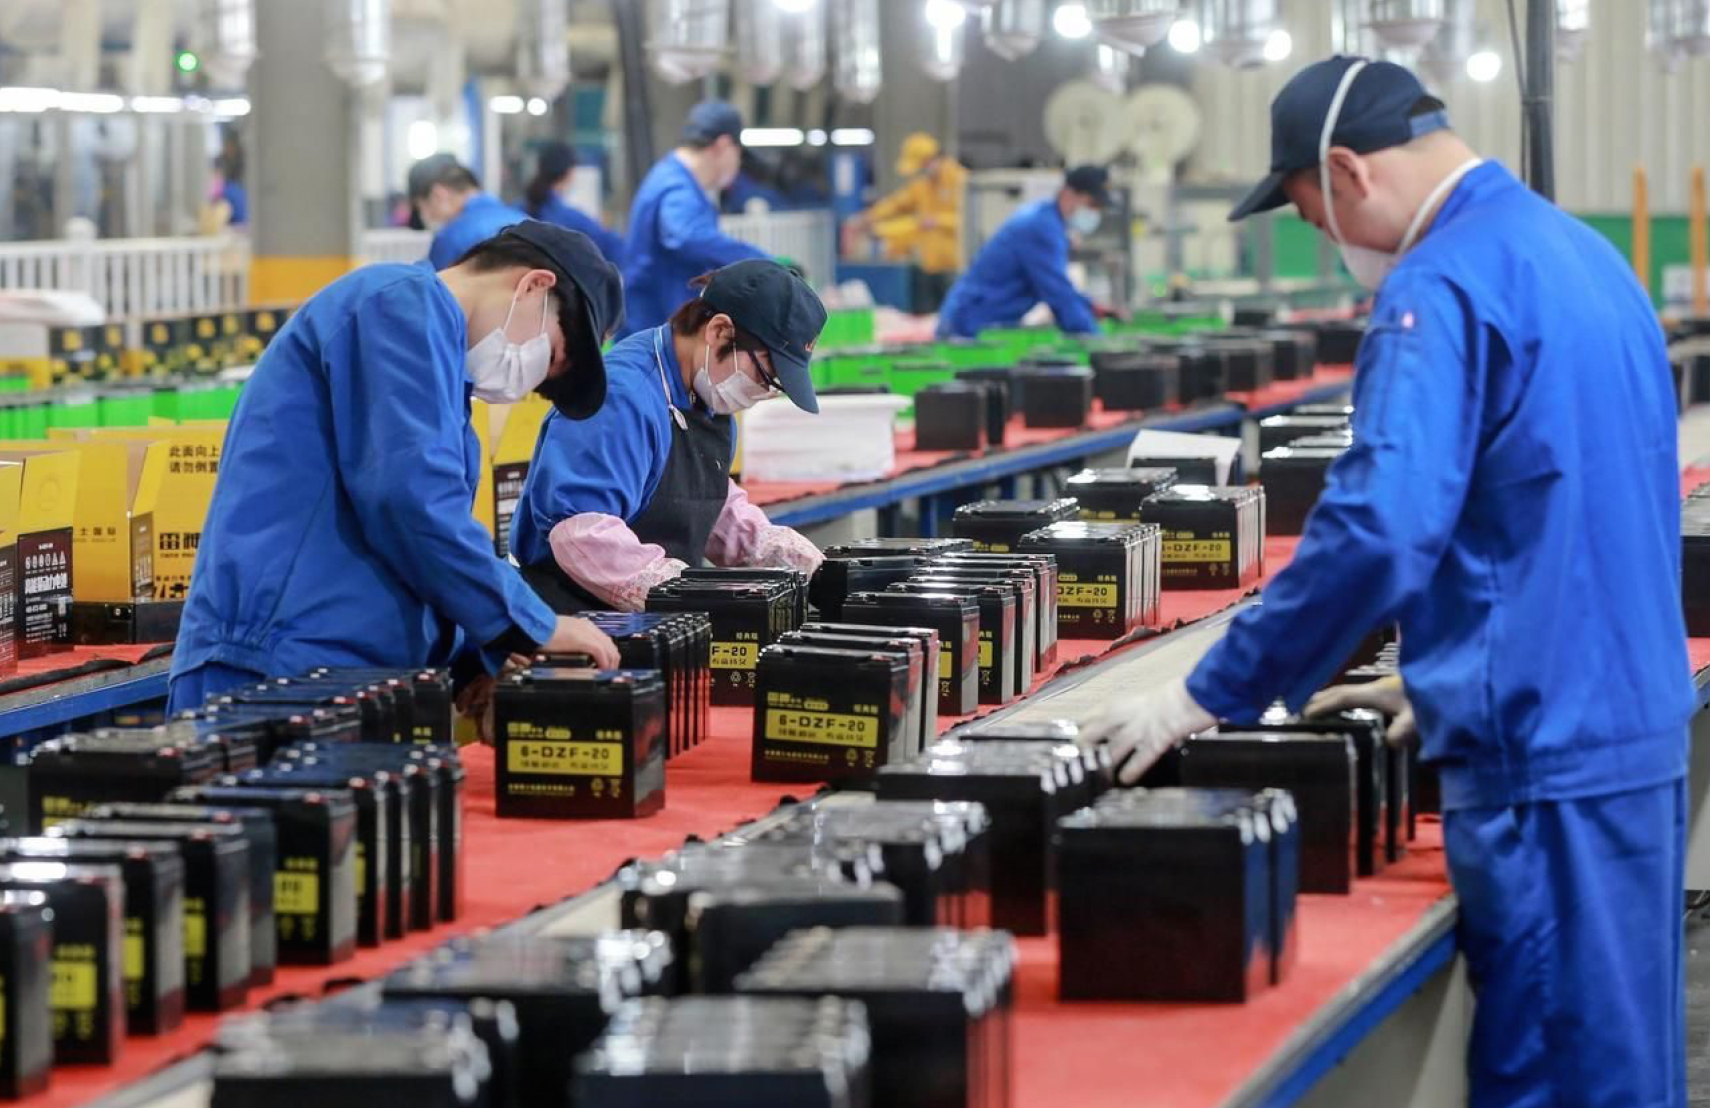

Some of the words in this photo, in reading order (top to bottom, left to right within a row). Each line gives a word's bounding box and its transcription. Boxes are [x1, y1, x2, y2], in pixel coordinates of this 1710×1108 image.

[170, 445, 221, 457] 此面向上
[779, 715, 866, 732] 6-DZF-20
[520, 746, 610, 759] 6-DZF-20
